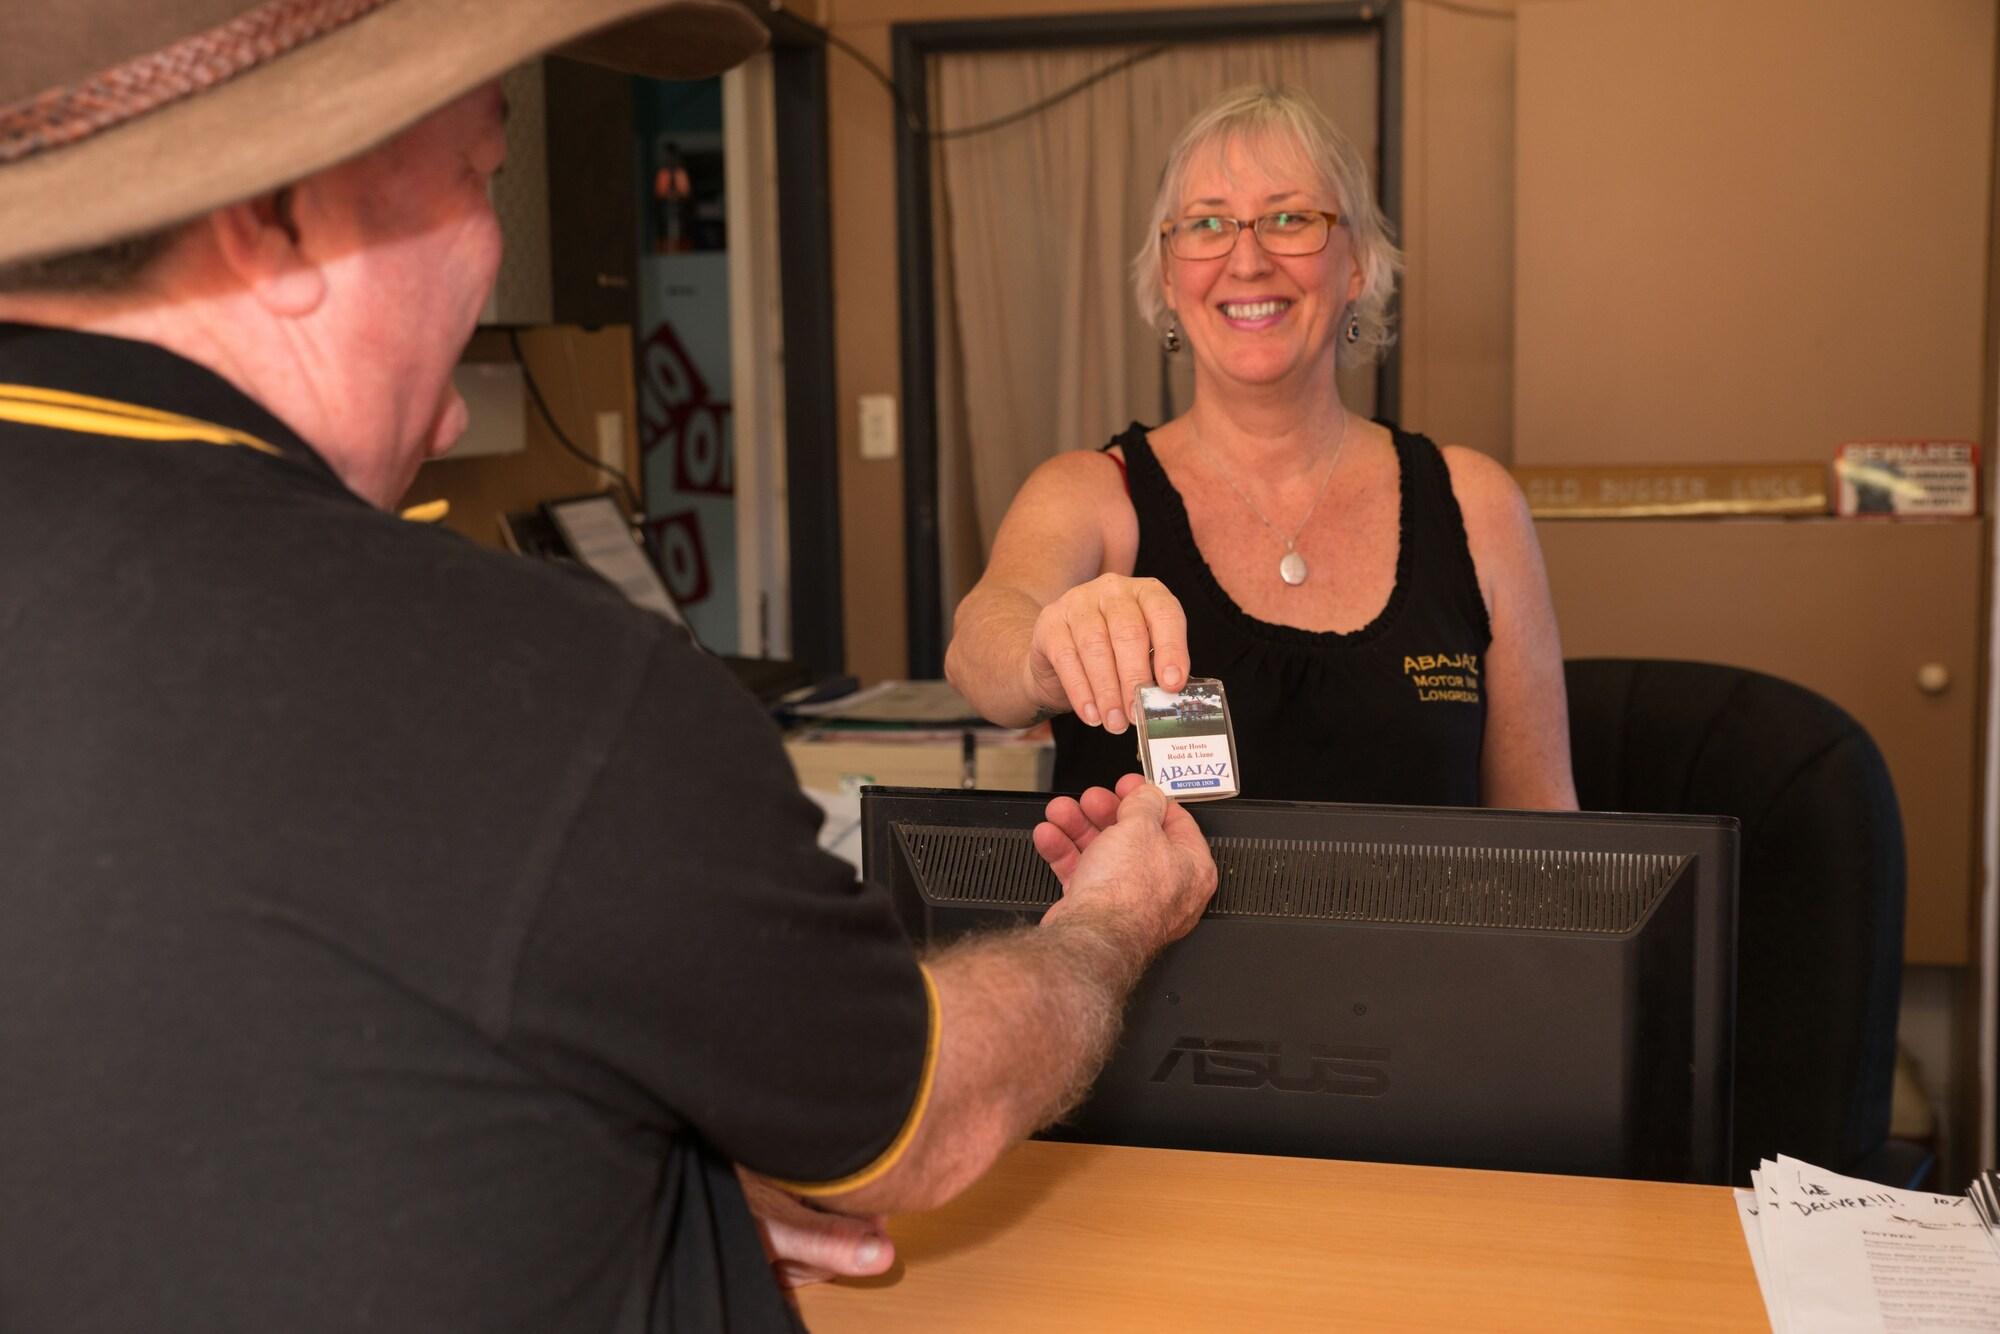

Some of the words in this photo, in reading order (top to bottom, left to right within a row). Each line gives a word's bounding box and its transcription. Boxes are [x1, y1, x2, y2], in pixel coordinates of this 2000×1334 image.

[1404, 653, 1479, 675] ABAJAZ
[1413, 675, 1464, 688] MOTOR
[1159, 763, 1230, 785] ABAJAZ
[1176, 780, 1201, 788] MOTOR
[1149, 1037, 1391, 1098] ASUS
